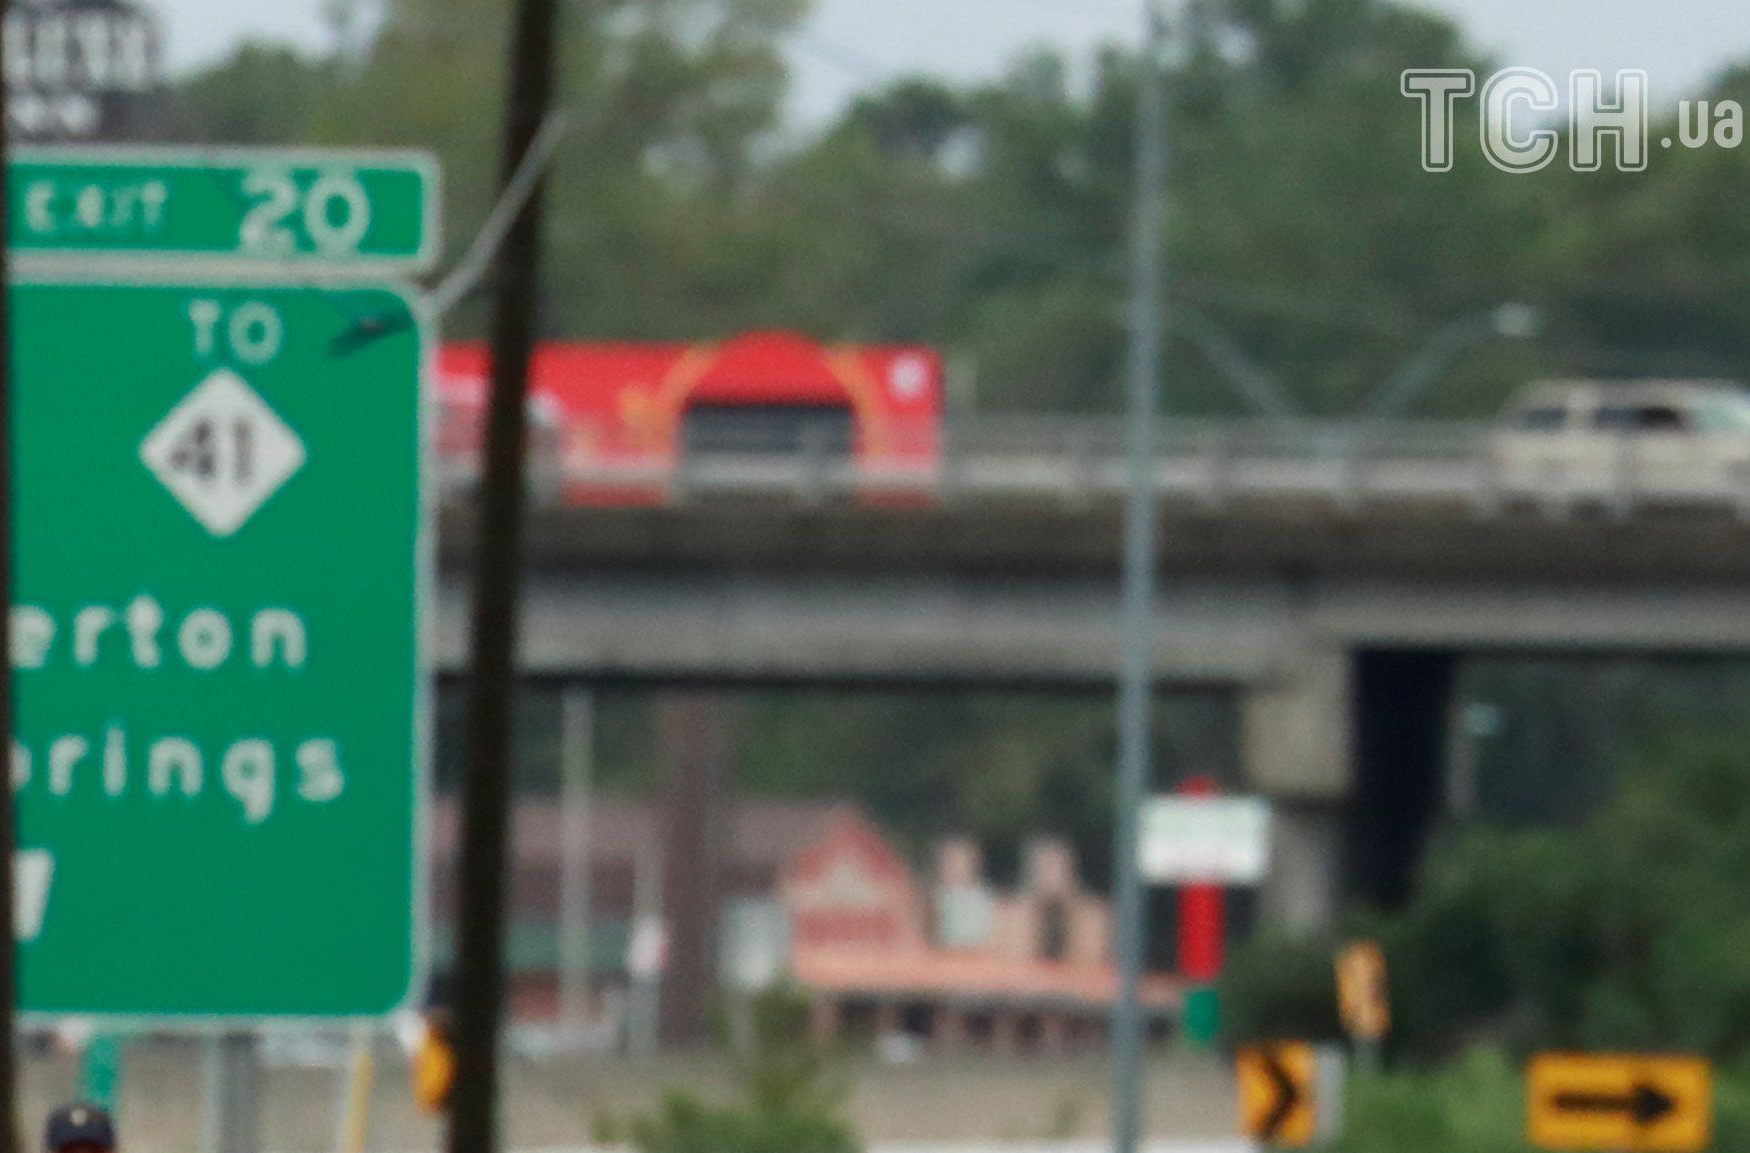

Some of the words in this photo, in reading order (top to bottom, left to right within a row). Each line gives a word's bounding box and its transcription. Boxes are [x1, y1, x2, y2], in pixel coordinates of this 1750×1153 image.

[240, 168, 370, 256] 20
[187, 299, 284, 364] TO
[172, 417, 251, 483] 41
